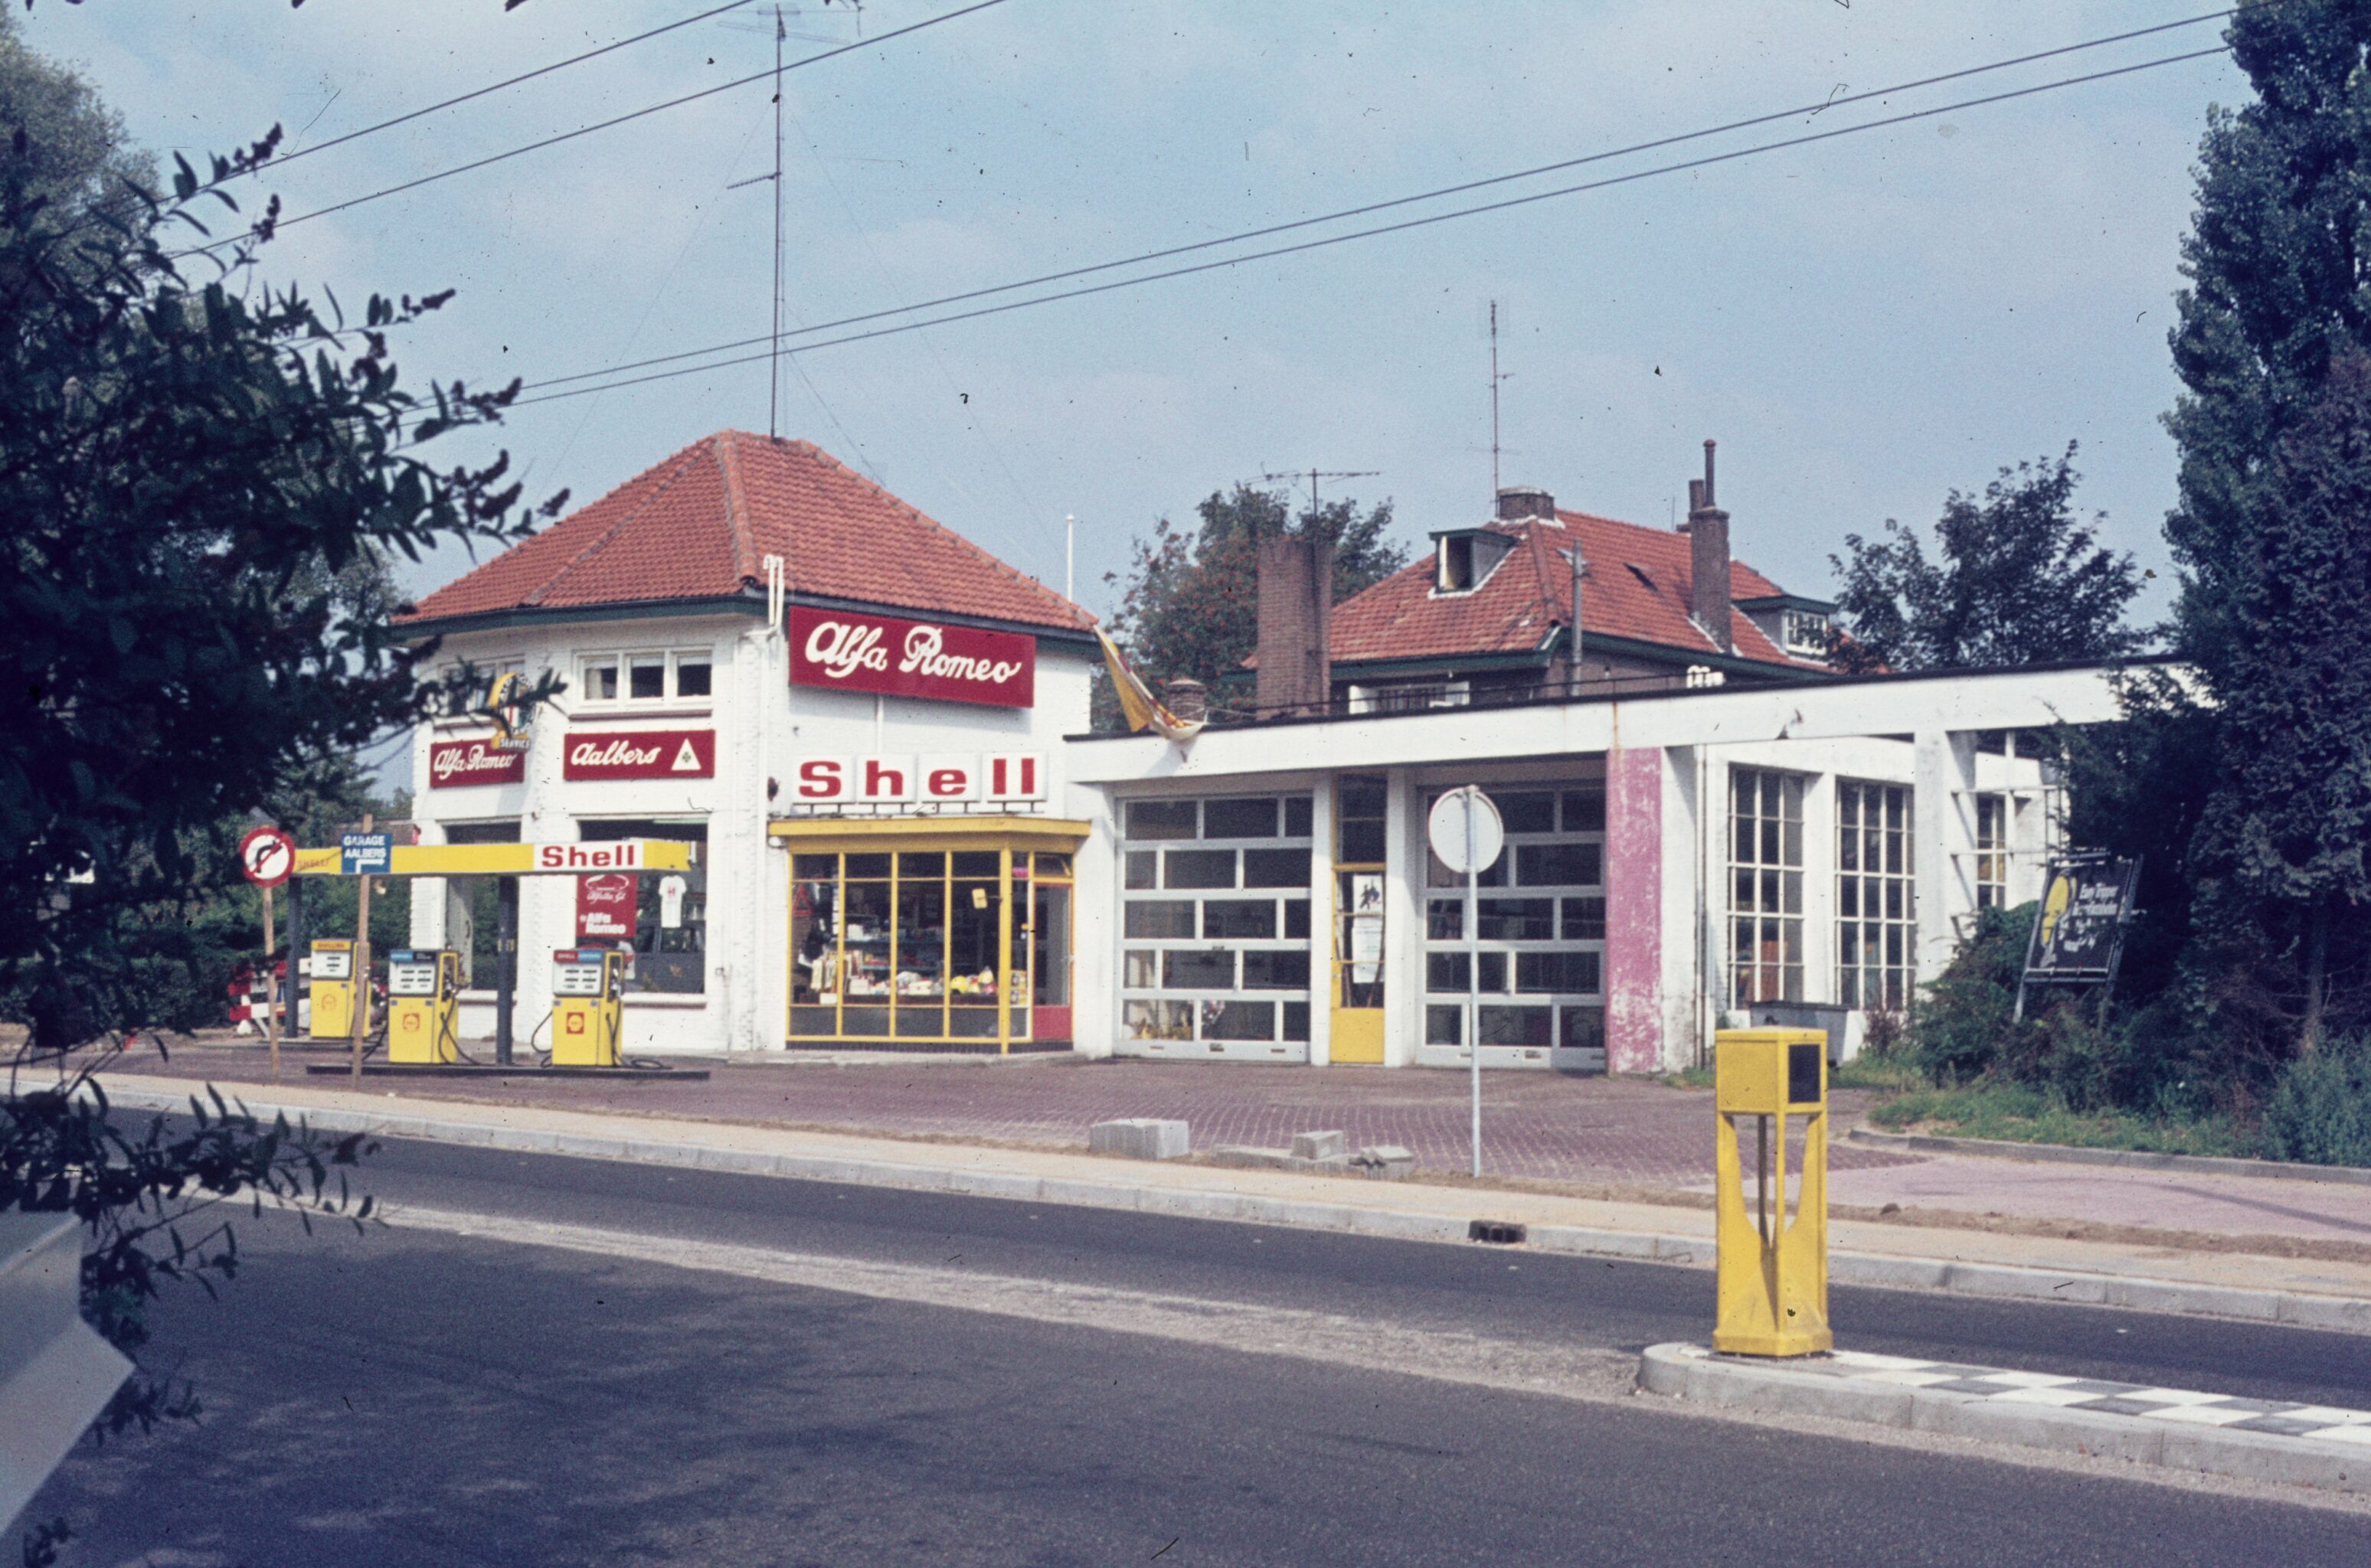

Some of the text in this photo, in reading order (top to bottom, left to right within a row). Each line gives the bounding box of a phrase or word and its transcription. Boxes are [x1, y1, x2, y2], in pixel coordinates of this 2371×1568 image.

[805, 621, 1022, 684] Alfa Romeo
[433, 743, 518, 780] Alfa Romeo
[571, 740, 662, 766] Aalbers
[799, 758, 1035, 798] Shell
[343, 835, 385, 846] GARAGE
[344, 848, 387, 858] AALBERS
[541, 844, 635, 867] Shell
[585, 923, 626, 934] Romeo
[587, 912, 611, 923] Alfa
